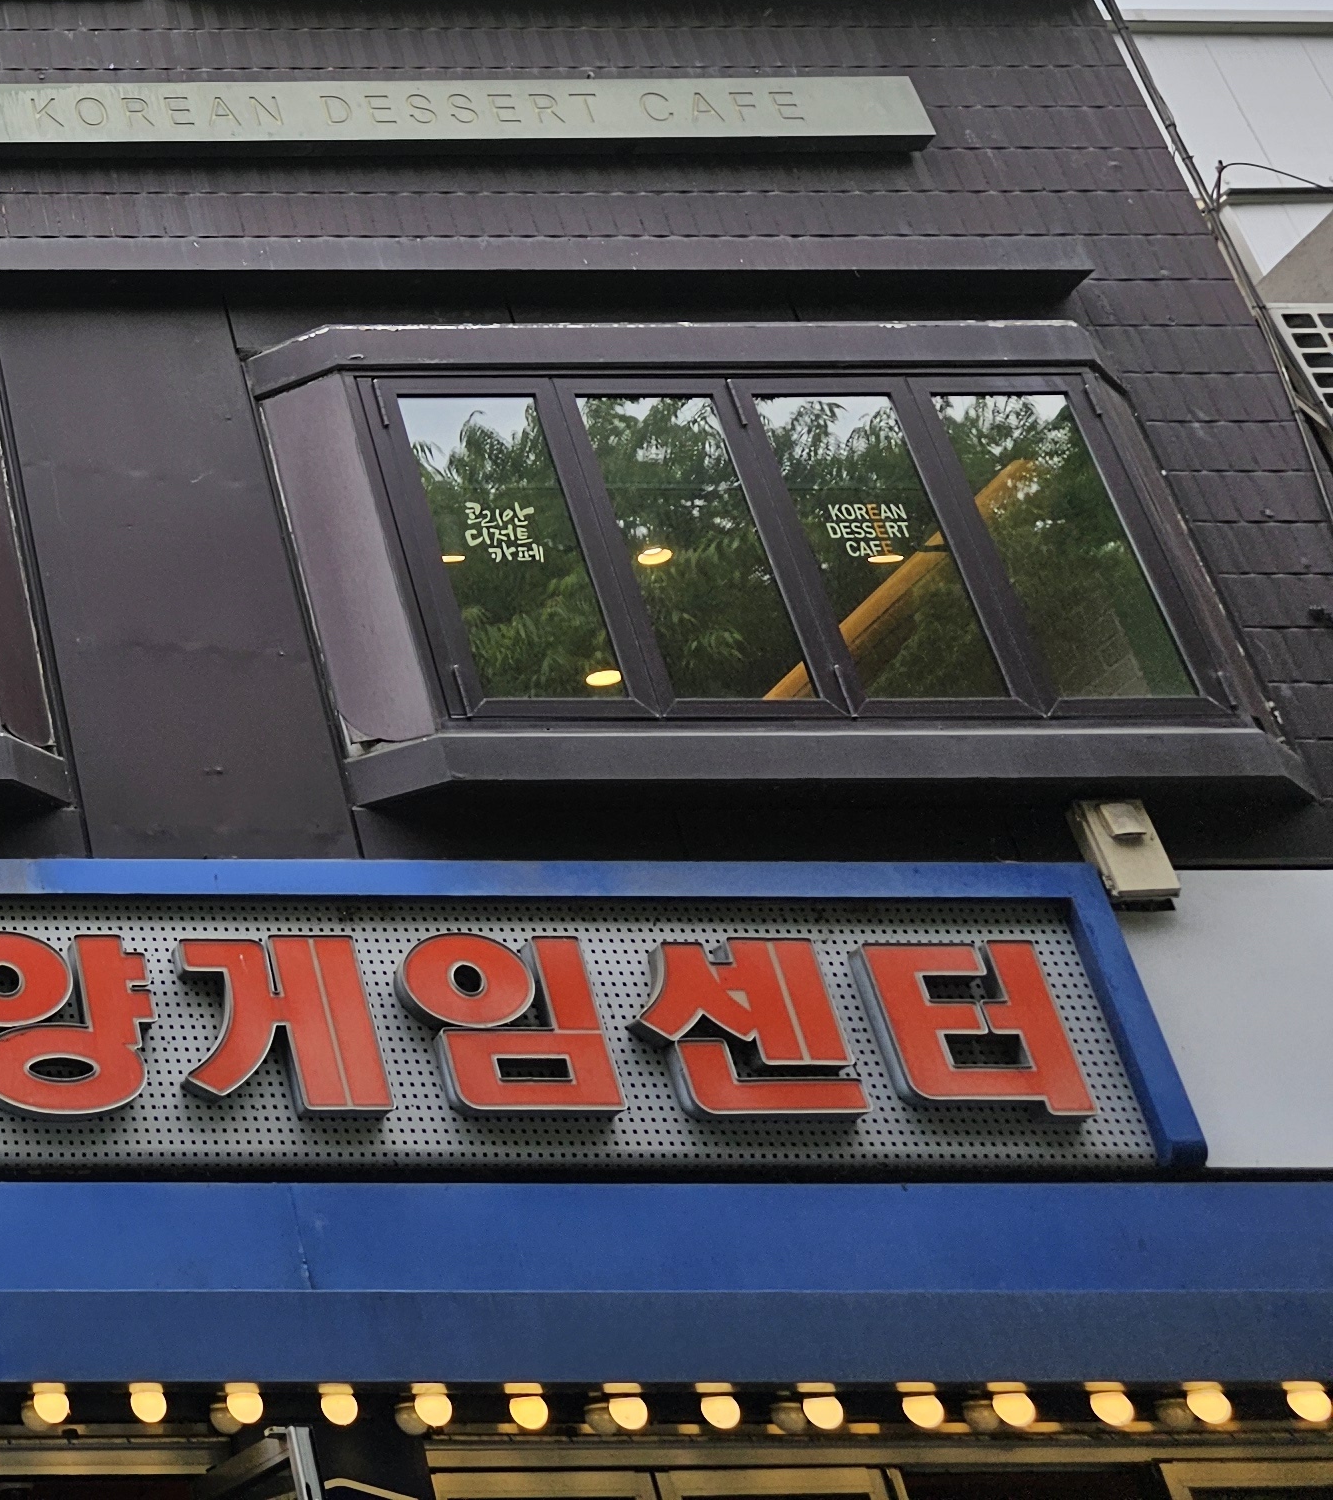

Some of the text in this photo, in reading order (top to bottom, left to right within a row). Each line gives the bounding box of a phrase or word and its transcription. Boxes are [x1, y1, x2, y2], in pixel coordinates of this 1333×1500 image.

[30, 90, 806, 128] KOREAN DESSERT CAFE
[465, 502, 534, 526] 코리안
[828, 504, 907, 520] KOREAN
[465, 524, 533, 546] 디저트
[826, 522, 909, 538] DESSERT
[488, 542, 544, 562] 카페
[846, 541, 893, 556] CAFE
